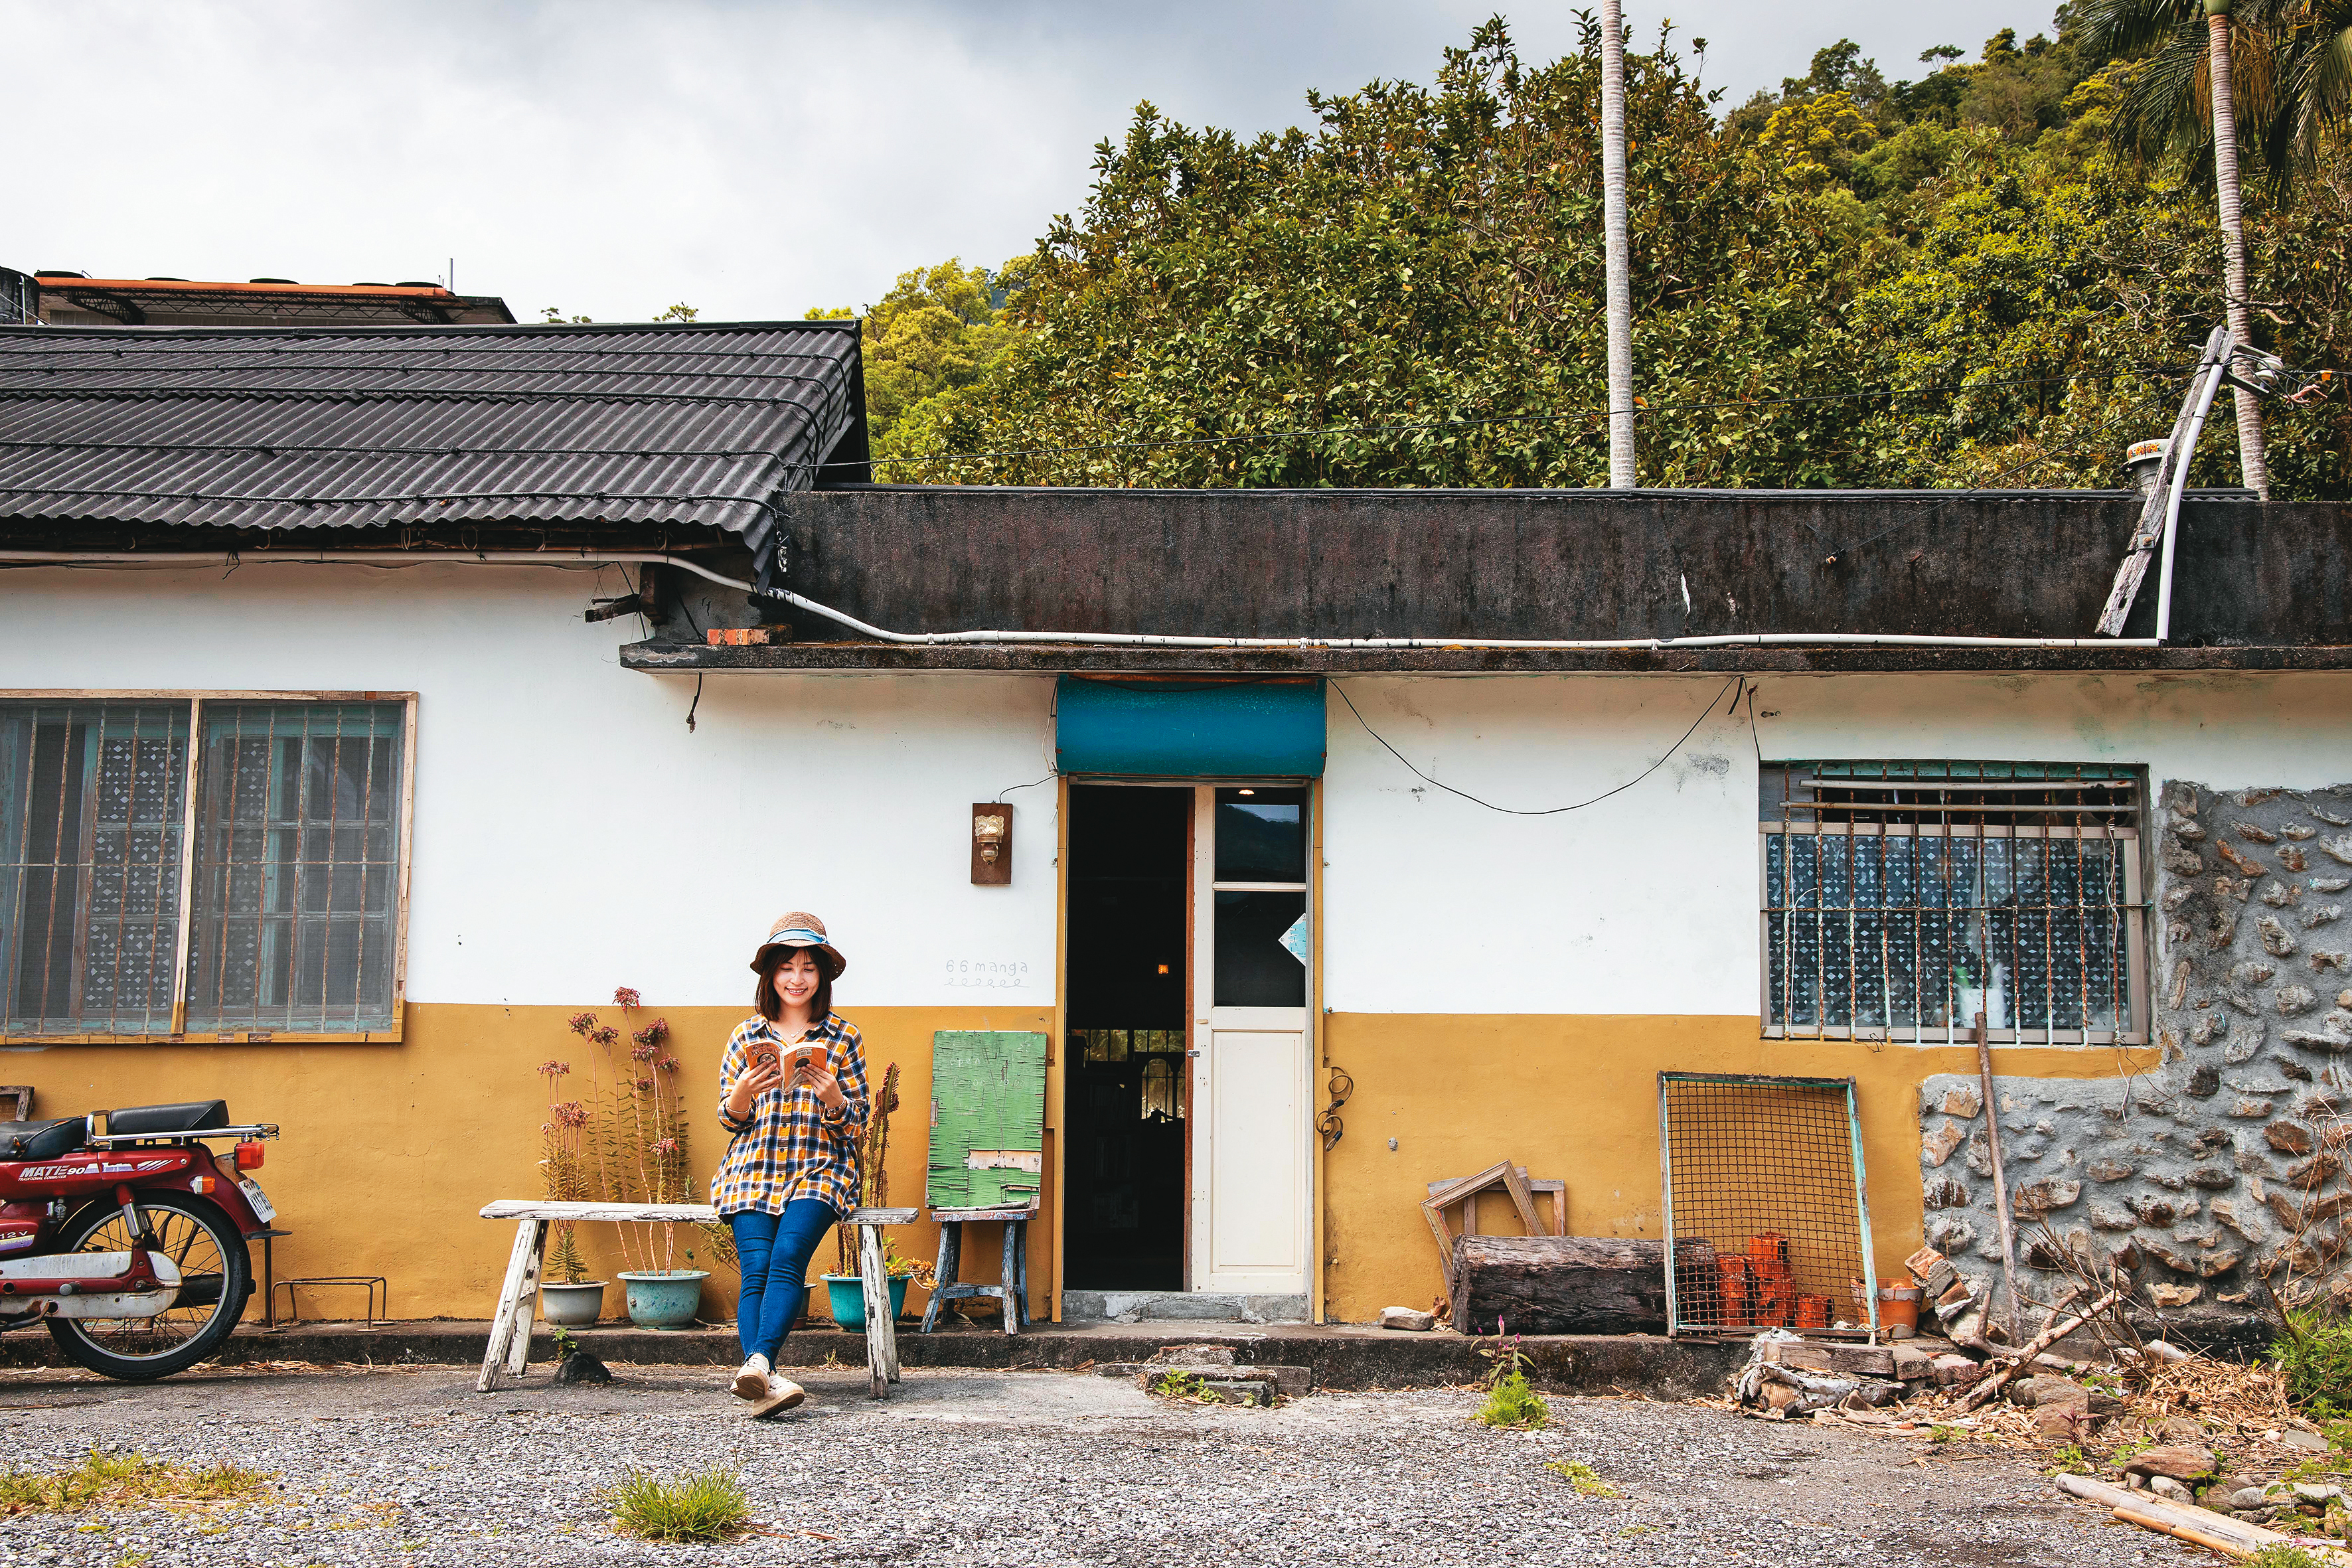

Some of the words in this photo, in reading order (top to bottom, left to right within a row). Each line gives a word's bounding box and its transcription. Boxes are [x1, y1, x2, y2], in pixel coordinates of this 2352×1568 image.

[946, 959, 969, 973] 66
[975, 961, 1028, 977] manga
[950, 1058, 980, 1068] open
